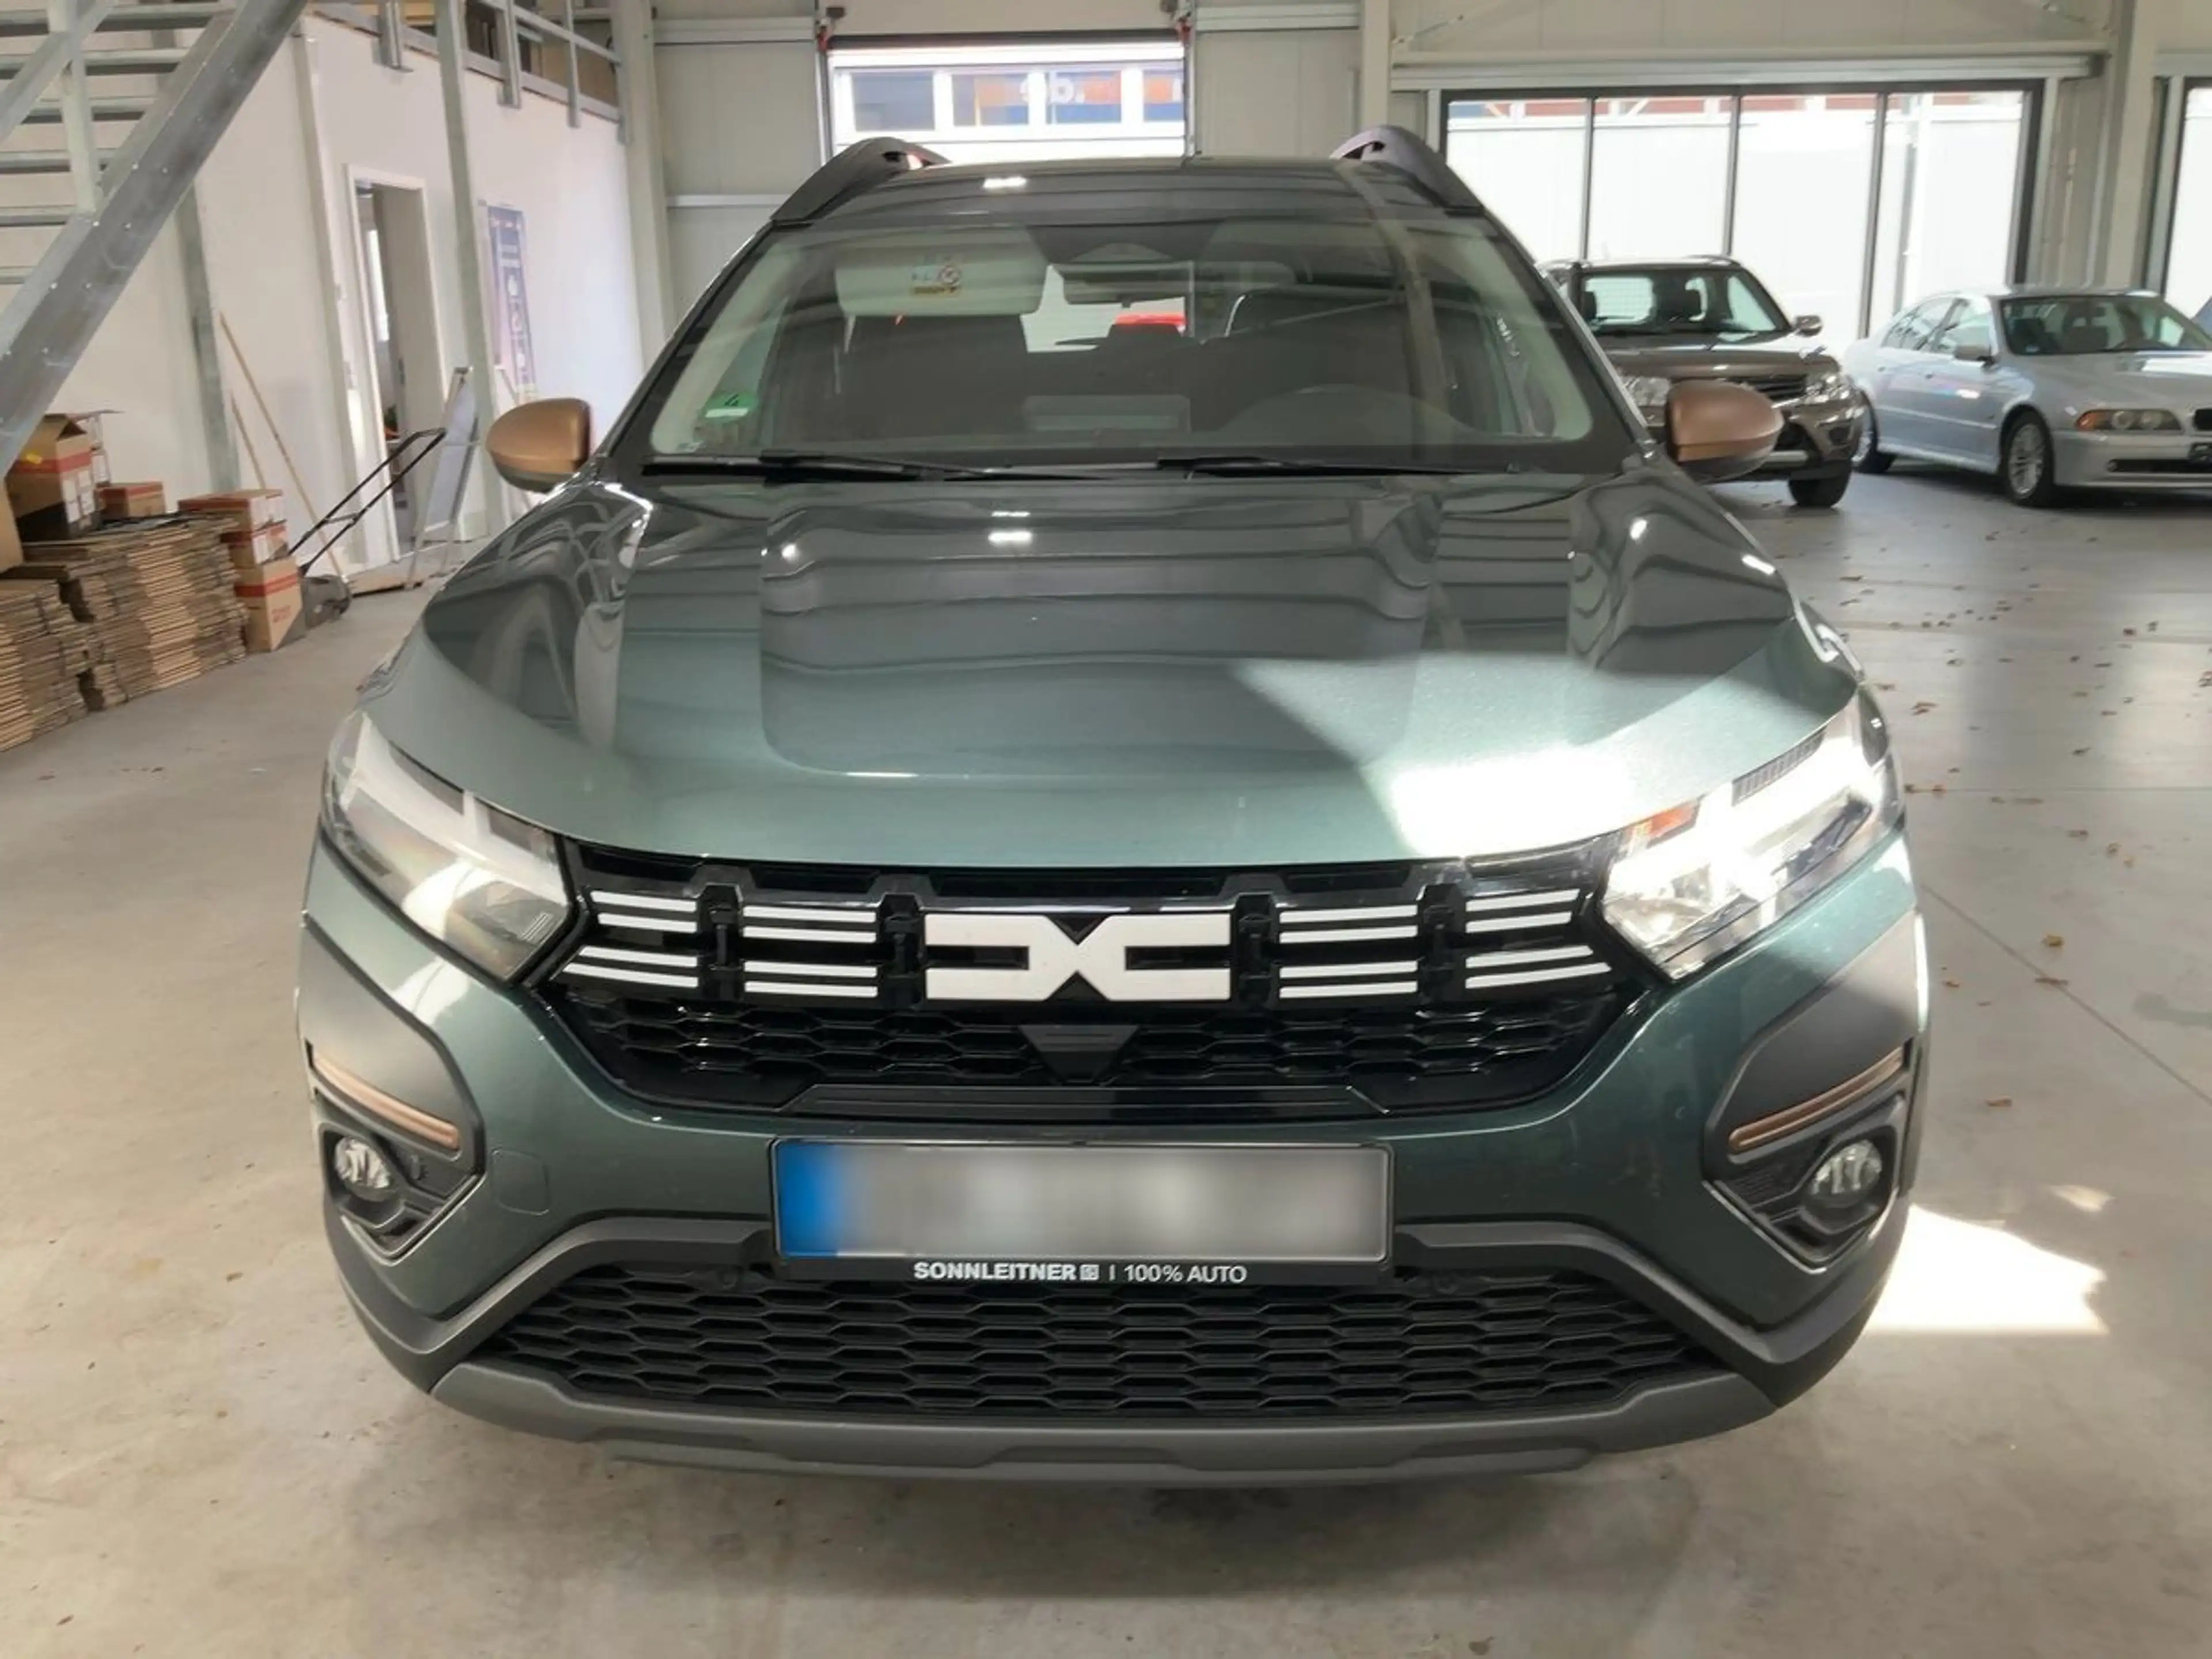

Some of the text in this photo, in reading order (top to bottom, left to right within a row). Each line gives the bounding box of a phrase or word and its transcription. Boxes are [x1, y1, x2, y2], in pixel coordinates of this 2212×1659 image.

[914, 1262, 1077, 1281] SONNLEITNER
[1124, 1264, 1183, 1282] 100%
[1187, 1266, 1248, 1283] AUTO
